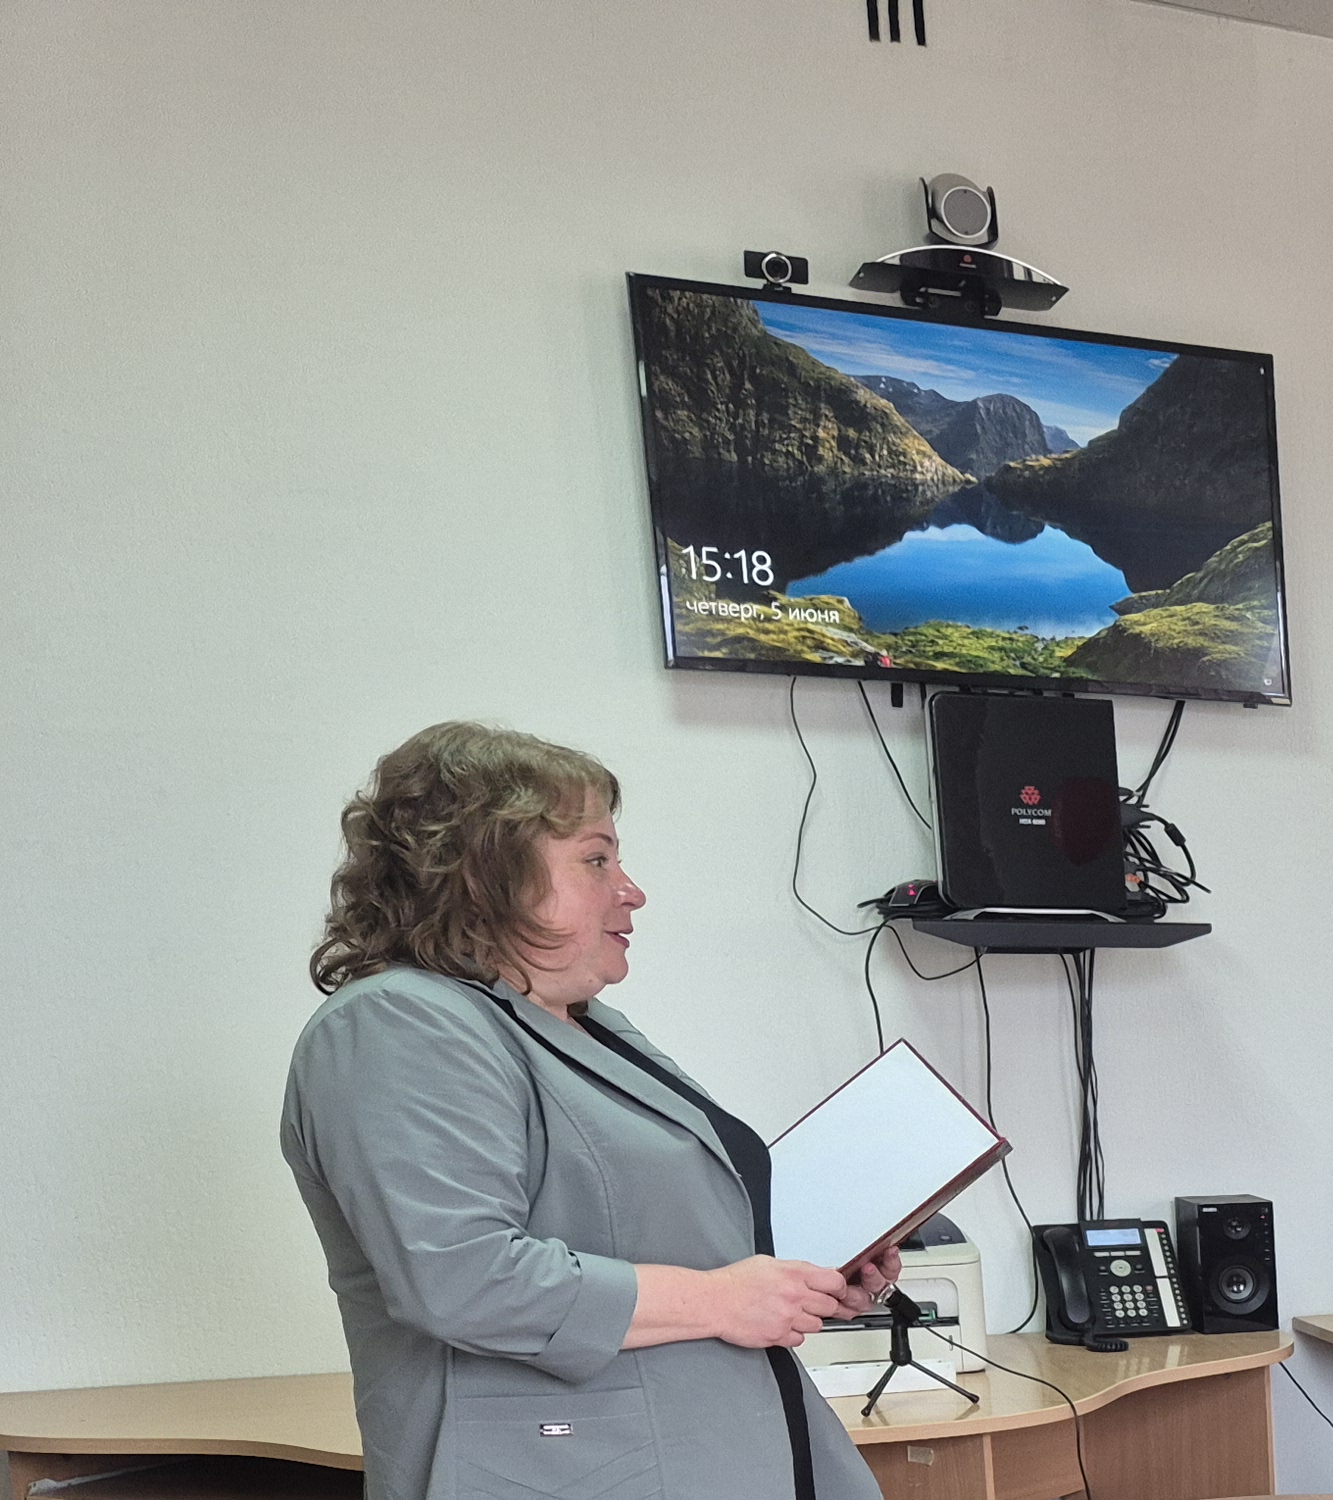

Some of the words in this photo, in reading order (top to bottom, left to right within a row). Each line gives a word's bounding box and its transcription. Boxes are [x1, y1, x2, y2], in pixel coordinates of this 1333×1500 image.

[682, 545, 775, 586] 15:18
[686, 600, 765, 620] четверг,
[771, 602, 782, 620] 5
[788, 607, 840, 624] июня
[1011, 807, 1052, 817] POLYCOM
